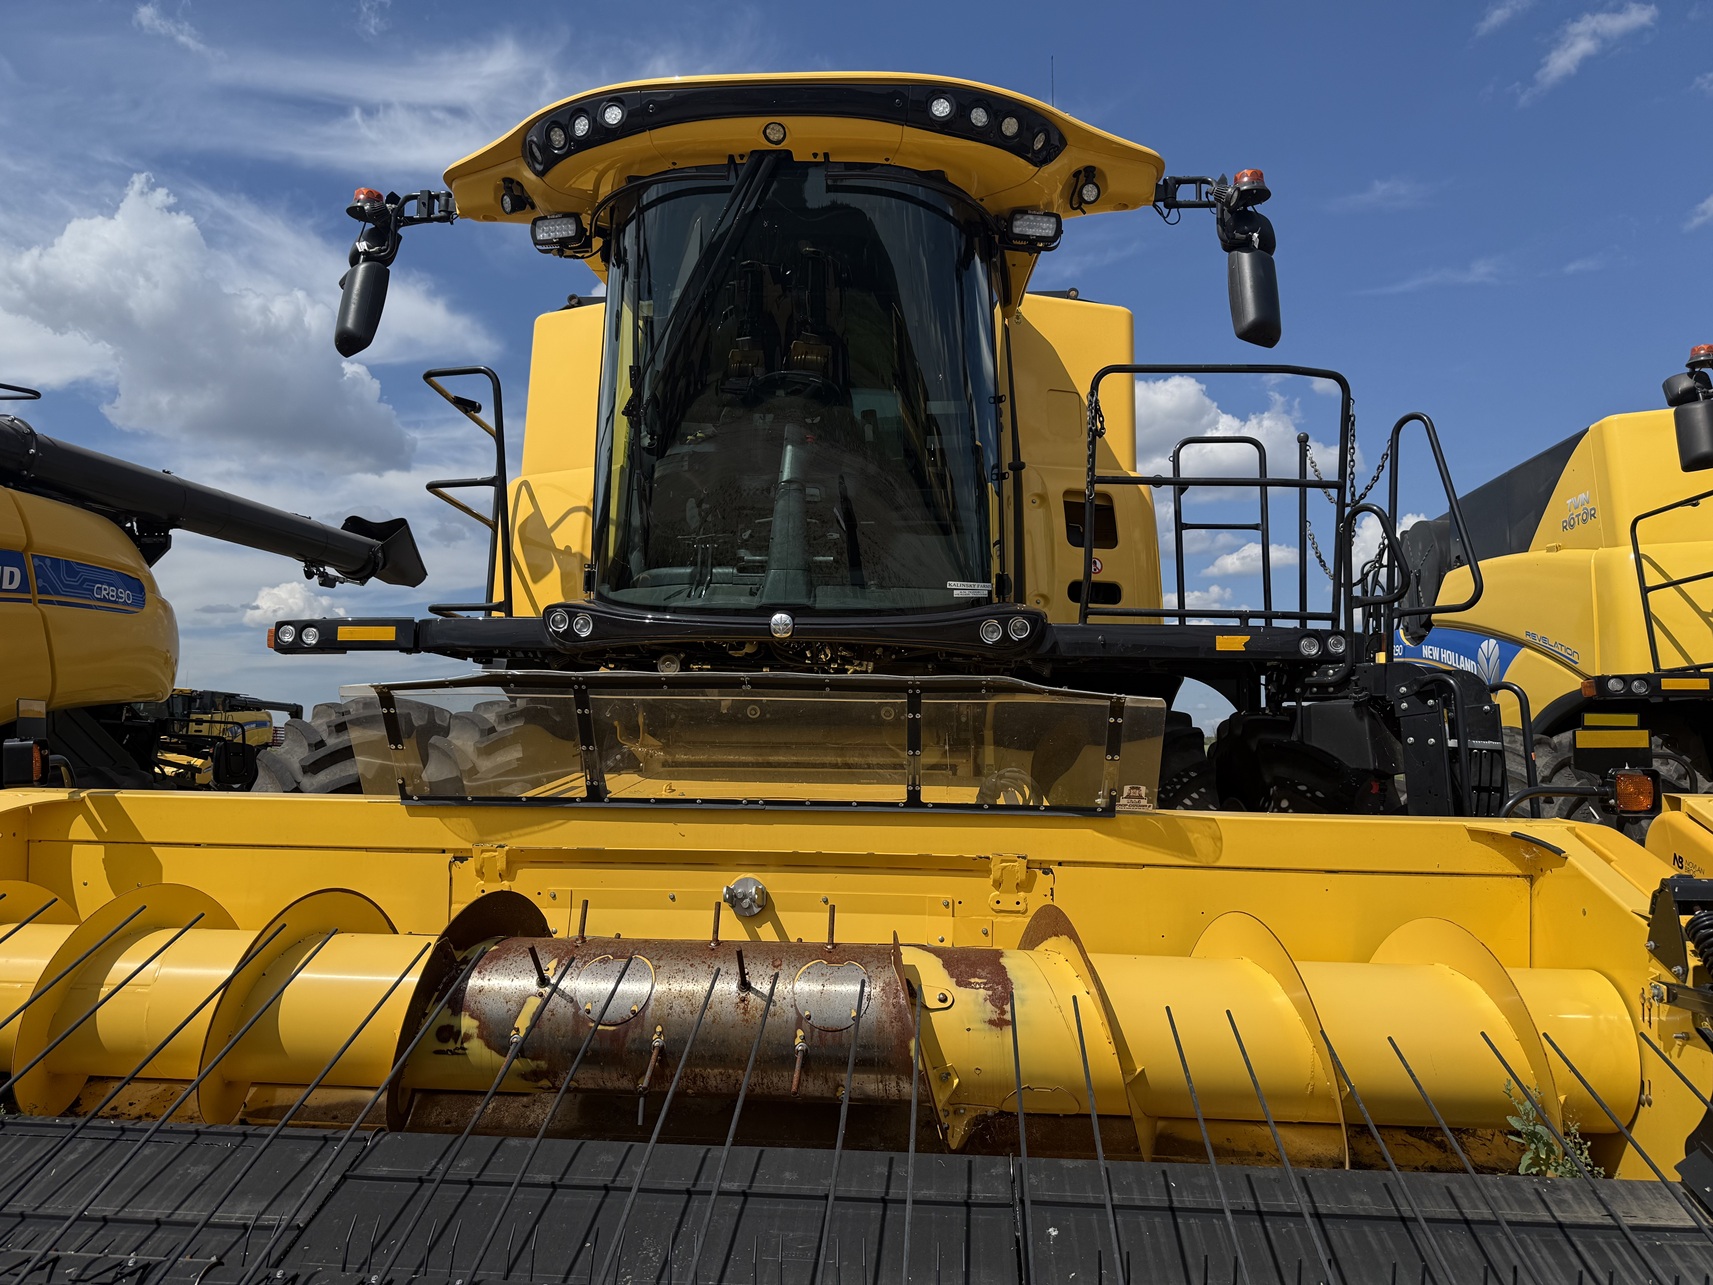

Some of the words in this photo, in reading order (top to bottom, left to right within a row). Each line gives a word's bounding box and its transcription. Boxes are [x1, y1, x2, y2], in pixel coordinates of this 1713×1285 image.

[1566, 490, 1590, 512] TWIN
[1562, 507, 1597, 532] ROTOR
[0, 566, 21, 590] D
[94, 583, 133, 604] CR8.90
[1525, 630, 1580, 661] REVELATION
[1422, 645, 1440, 661] NEW
[1441, 648, 1477, 674] HOLLAND
[1673, 852, 1684, 870] NB
